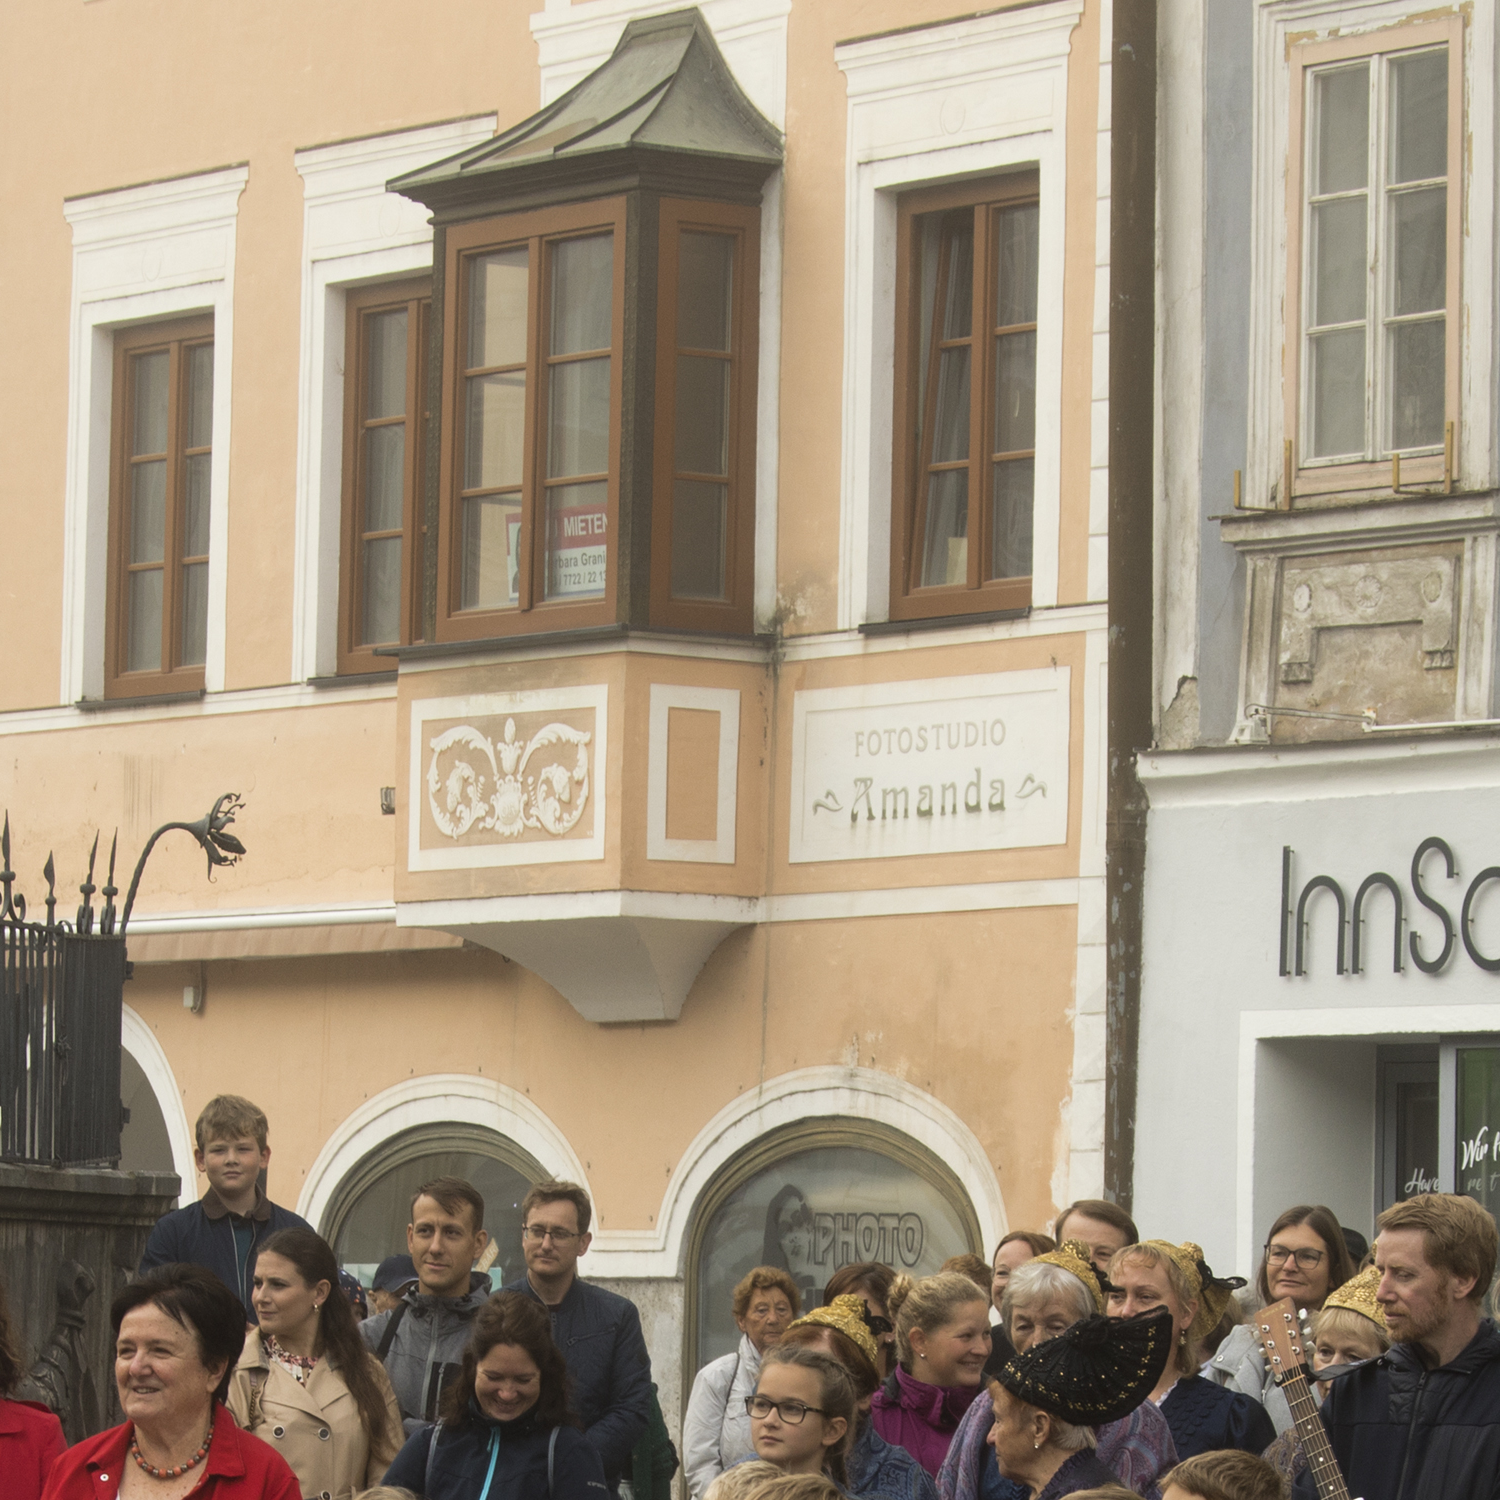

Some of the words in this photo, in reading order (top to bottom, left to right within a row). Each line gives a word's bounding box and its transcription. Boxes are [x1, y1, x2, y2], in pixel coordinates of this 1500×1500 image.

[581, 551, 606, 566] Grani
[854, 718, 1007, 757] FOTOSTUDIO
[850, 766, 1007, 823] Amanda
[1460, 1125, 1489, 1171] Wir
[813, 1212, 924, 1270] PHOTO
